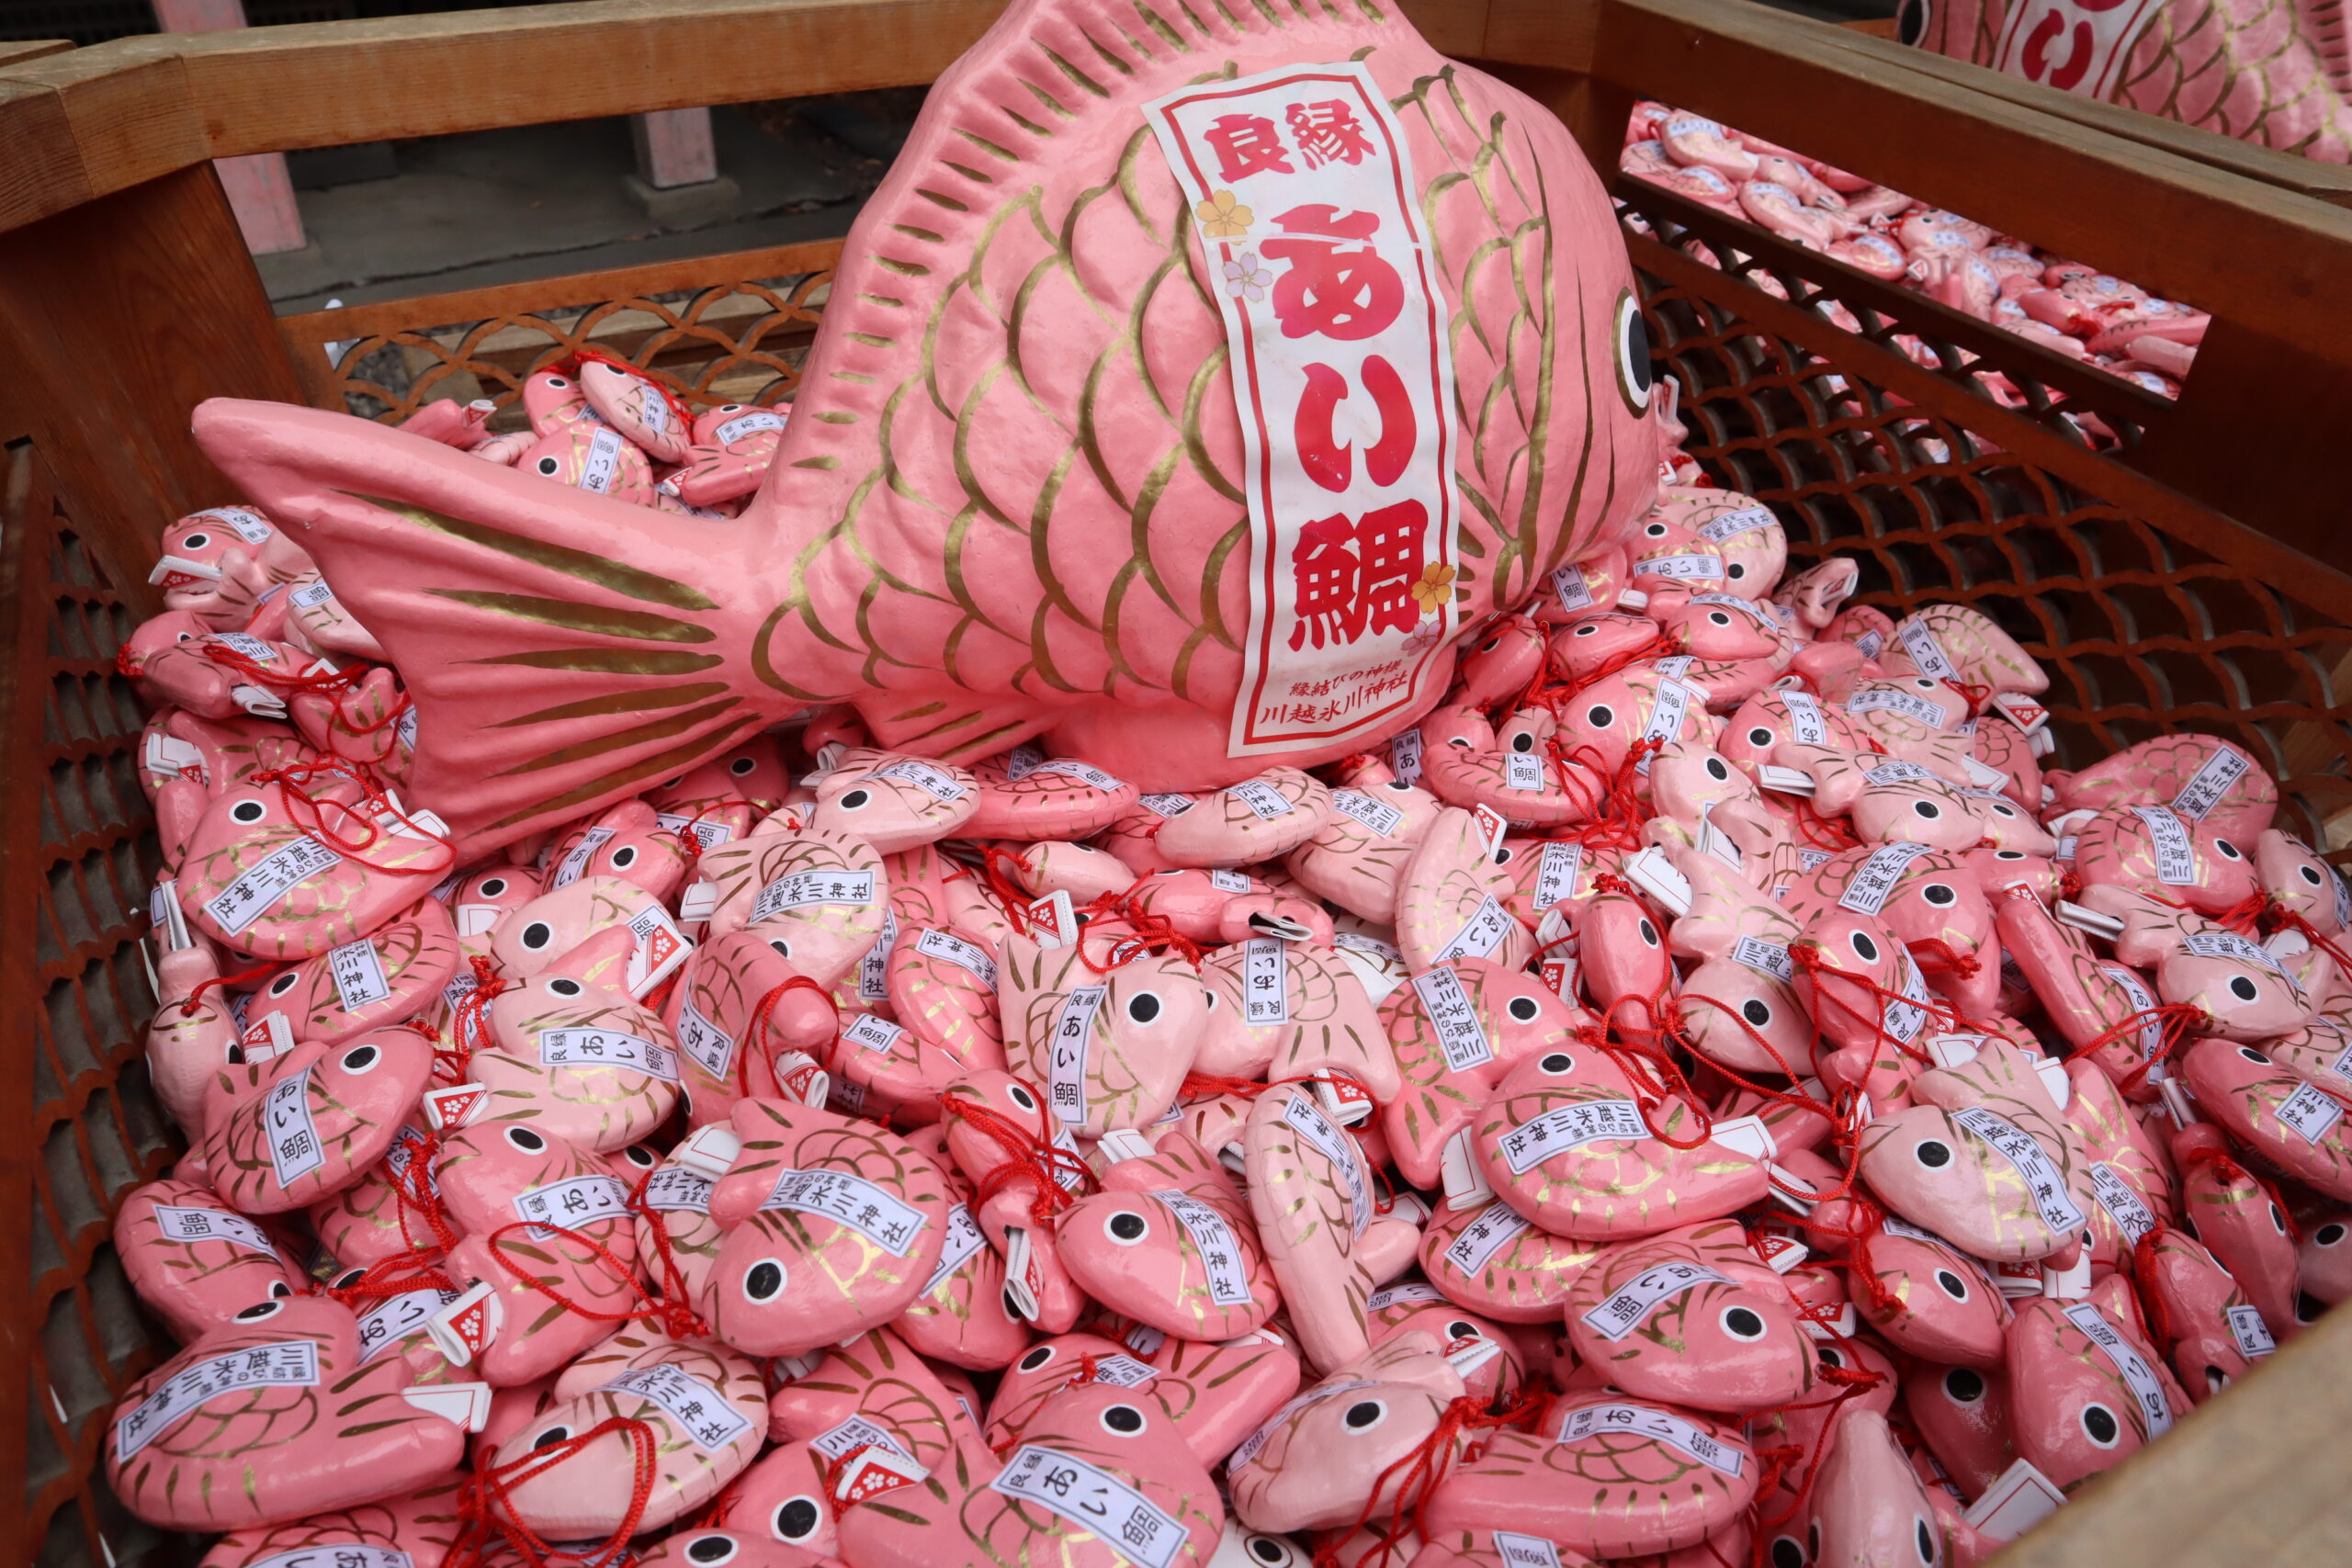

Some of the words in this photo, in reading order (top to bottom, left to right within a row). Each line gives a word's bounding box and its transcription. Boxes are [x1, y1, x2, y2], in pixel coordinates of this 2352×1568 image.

[1204, 98, 1375, 184] 良縁
[1260, 204, 1429, 653] あい鯛
[1261, 671, 1408, 727] 川越氷川神社
[1289, 660, 1401, 699] 縁結びの神様
[1069, 993, 1098, 1007] 良縁
[1429, 972, 1484, 1056] 川越氷川神社
[549, 1032, 568, 1062] 良縁
[580, 1034, 666, 1075] あい鯛
[1053, 1015, 1081, 1109] あい鯛
[274, 1083, 313, 1168] あい鯛
[1507, 1103, 1636, 1157] 川越氷川神社
[1966, 1111, 2069, 1225] 川越氷川神社
[1603, 1263, 1700, 1324] あい鯛
[128, 1347, 304, 1439] 川越氷川神社
[1605, 1408, 1721, 1466] あい鯛
[1008, 1453, 1044, 1488] 良縁
[1042, 1464, 1163, 1555] あい鯛
